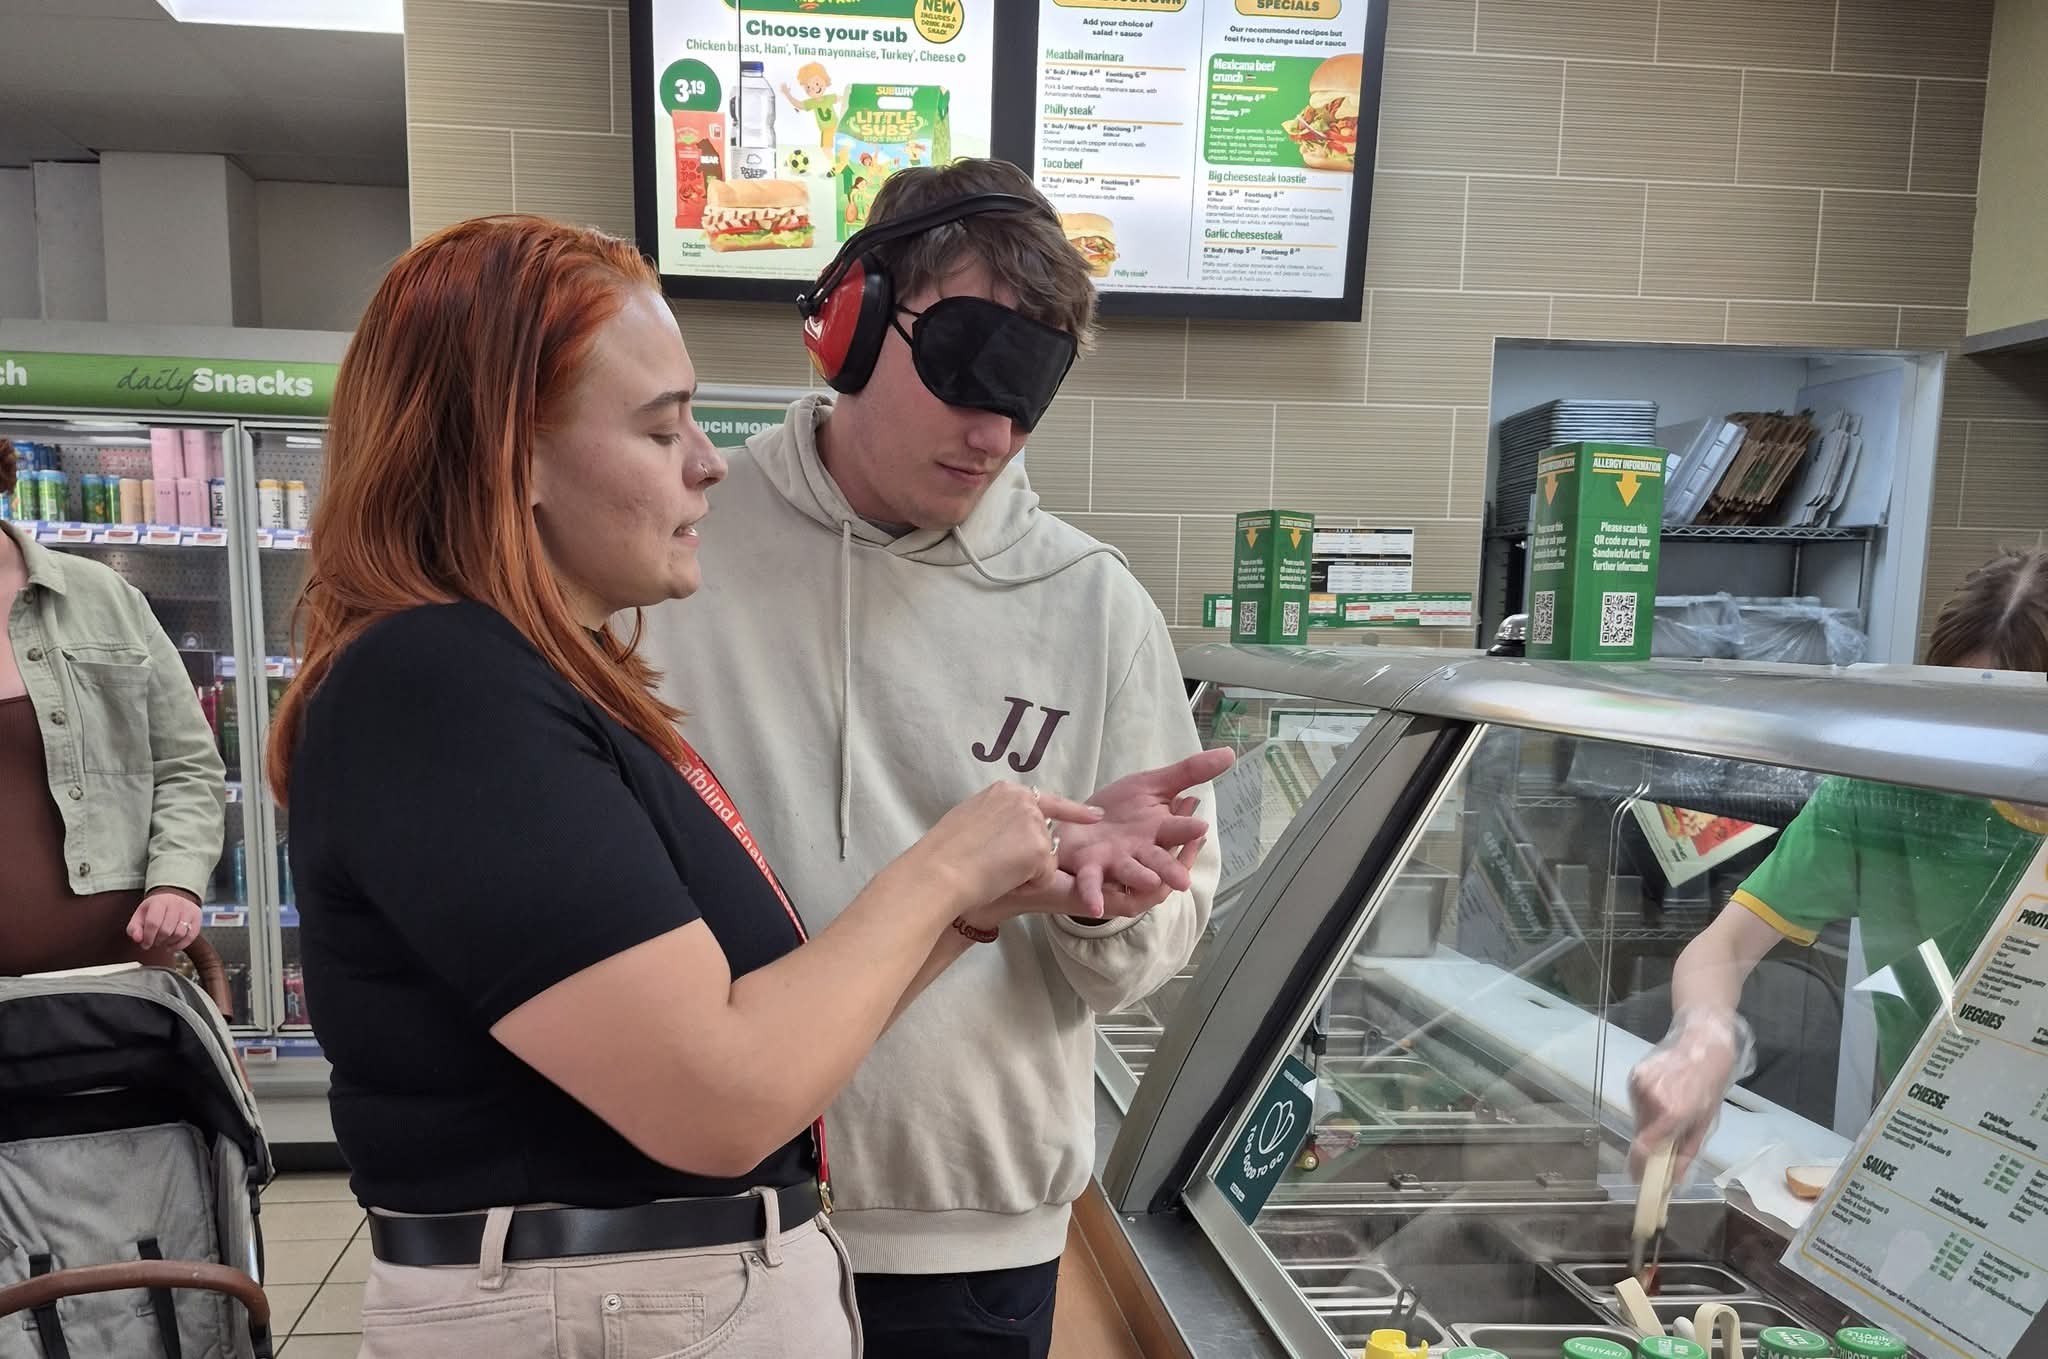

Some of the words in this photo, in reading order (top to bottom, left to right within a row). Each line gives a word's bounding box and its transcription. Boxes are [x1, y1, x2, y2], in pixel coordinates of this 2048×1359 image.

[923, 0, 956, 14] NEW
[1257, 0, 1320, 11] SPECIALS
[921, 12, 951, 21] INCLUDES
[1083, 18, 1098, 26] Add
[1100, 19, 1117, 27] your
[1118, 20, 1144, 28] choice
[746, 19, 821, 39] Choose
[825, 27, 869, 43] your
[872, 26, 908, 43] sub
[1245, 27, 1300, 35] recommended
[1301, 29, 1329, 37] recipes
[1240, 35, 1256, 43] free
[1265, 37, 1294, 46] change
[1294, 37, 1314, 45] salad
[686, 38, 726, 52] Chicken
[793, 43, 816, 56] Tuna
[818, 46, 879, 60] mayonnaise,
[920, 50, 956, 63] Cheese
[1046, 48, 1084, 60] Meatball
[1085, 51, 1124, 62] marinara
[1256, 60, 1276, 72] beef
[674, 79, 706, 103] 3.19
[875, 86, 919, 97] SUBWAY
[1044, 104, 1069, 116] Philly
[856, 110, 917, 125] LITTLE
[861, 124, 912, 136] SUBS
[1042, 158, 1062, 168] Taco
[1064, 159, 1084, 169] beef
[1208, 170, 1223, 183] Big
[1223, 171, 1276, 183] cheesesteak
[1277, 174, 1307, 184] toastie
[1205, 228, 1229, 239] Garlic
[1230, 229, 1283, 240] cheesesteak
[117, 367, 198, 404] daily
[192, 368, 313, 397] Snacks
[1593, 457, 1622, 470] ALLERGY
[1622, 459, 1661, 472] INFORMATION
[1600, 521, 1622, 533] Please
[1623, 524, 1637, 533] scan
[1637, 523, 1648, 534] this
[1594, 534, 1605, 545] QR
[1605, 535, 1620, 545] code
[1621, 538, 1628, 546] or
[1628, 536, 1638, 546] ask
[1638, 538, 1651, 548] your
[1592, 547, 1624, 558] Sandwich
[1643, 549, 1651, 560] for
[1593, 560, 1616, 571] further
[1616, 561, 1648, 572] information
[972, 696, 1070, 772] JJ
[678, 761, 735, 822] afblind
[1959, 1003, 2005, 1030] VEGGIES
[1907, 1083, 1950, 1110] CHEESE
[1245, 1124, 1258, 1154] TOO
[1243, 1154, 1257, 1180] GOOD
[1269, 1151, 1285, 1170] GO
[1257, 1164, 1269, 1179] TO
[1862, 1155, 1899, 1181] SAUCE
[1575, 1343, 1623, 1357] TERIYAKI
